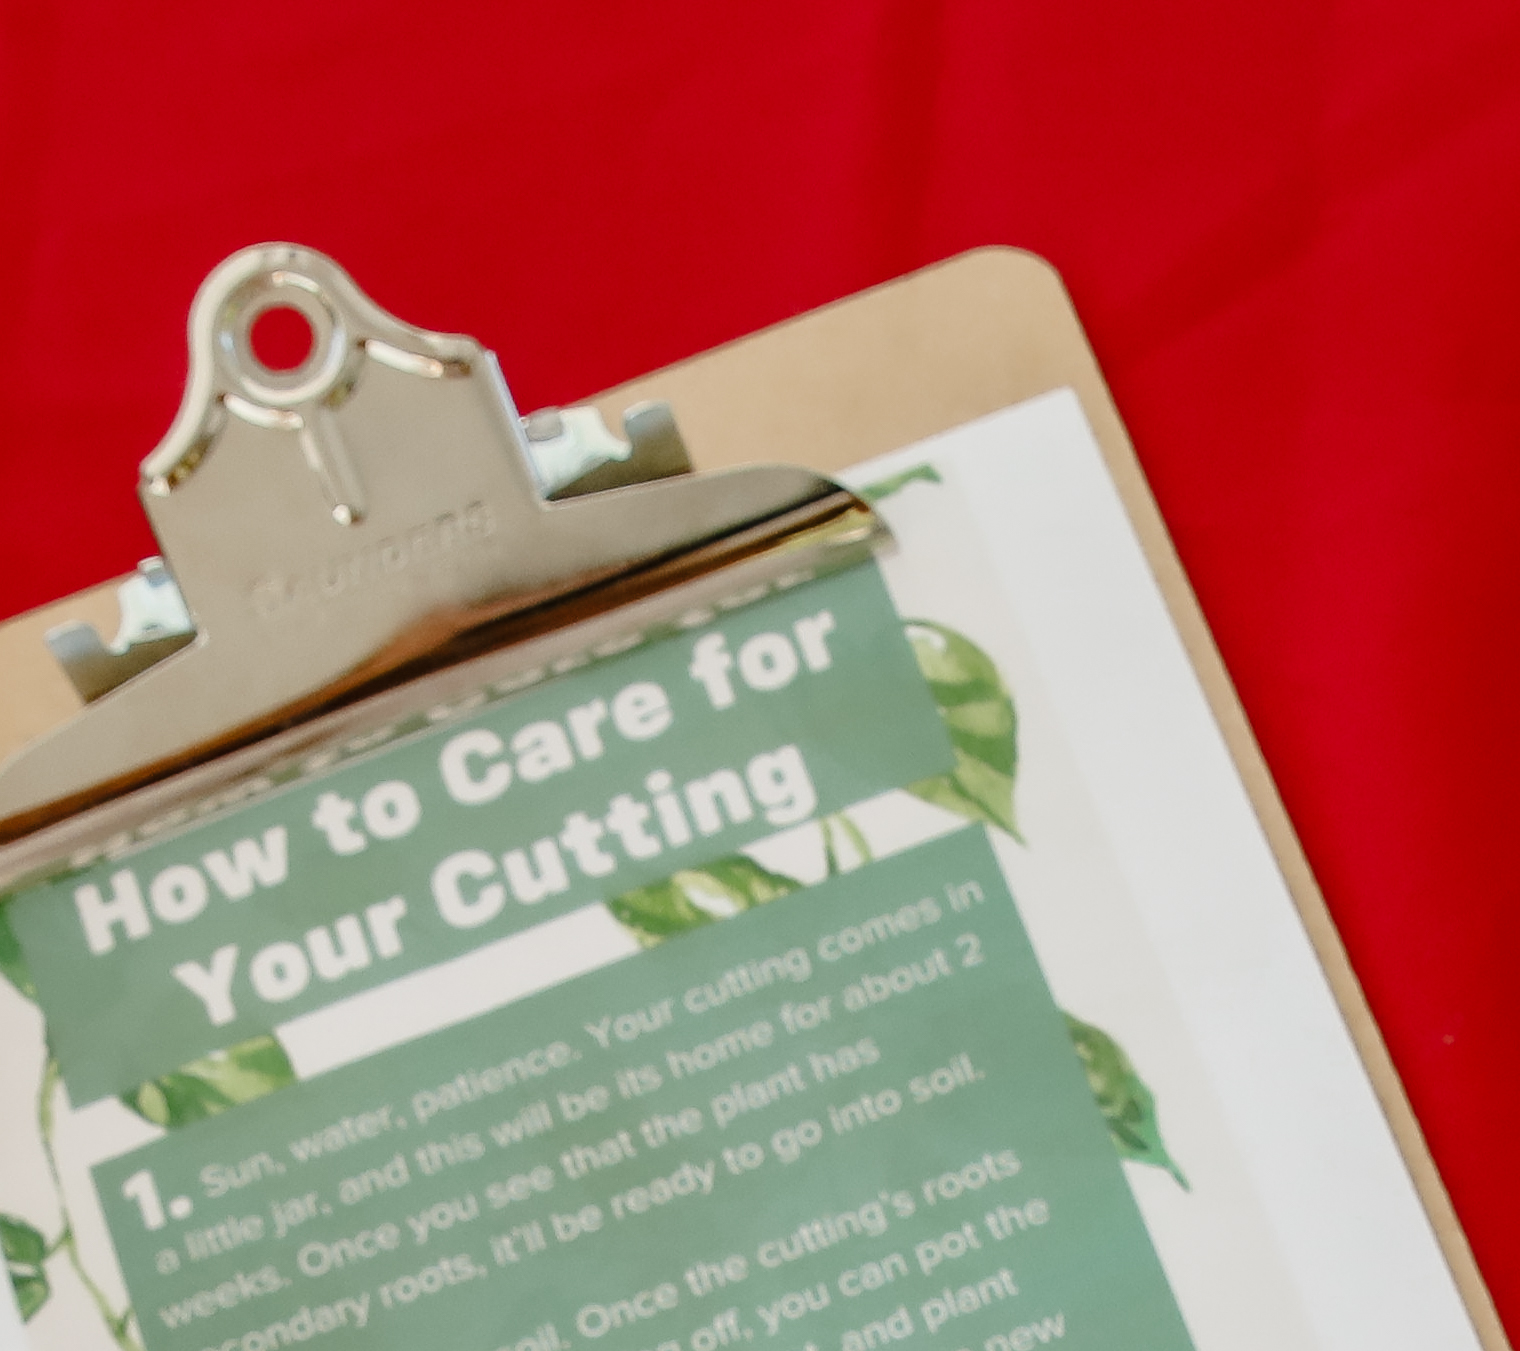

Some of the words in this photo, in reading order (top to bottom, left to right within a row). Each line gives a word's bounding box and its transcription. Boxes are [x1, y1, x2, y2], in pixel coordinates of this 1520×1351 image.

[73, 825, 289, 956] How
[311, 779, 422, 856] to
[439, 680, 674, 805] Care
[688, 608, 836, 710] for
[170, 894, 407, 1026] Your
[429, 742, 811, 926] Cutting
[124, 1169, 192, 1230] 1.
[197, 1150, 287, 1198] Sun,
[287, 1103, 407, 1162] water,
[409, 1039, 582, 1124] patience.
[582, 996, 674, 1048] Your
[682, 945, 812, 1014] cutting
[815, 895, 943, 962] comes
[943, 878, 985, 913] in
[574, 1281, 679, 1339] Once
[681, 1253, 749, 1297] the
[755, 1189, 916, 1269] cutting's
[920, 1147, 1023, 1205] roots
